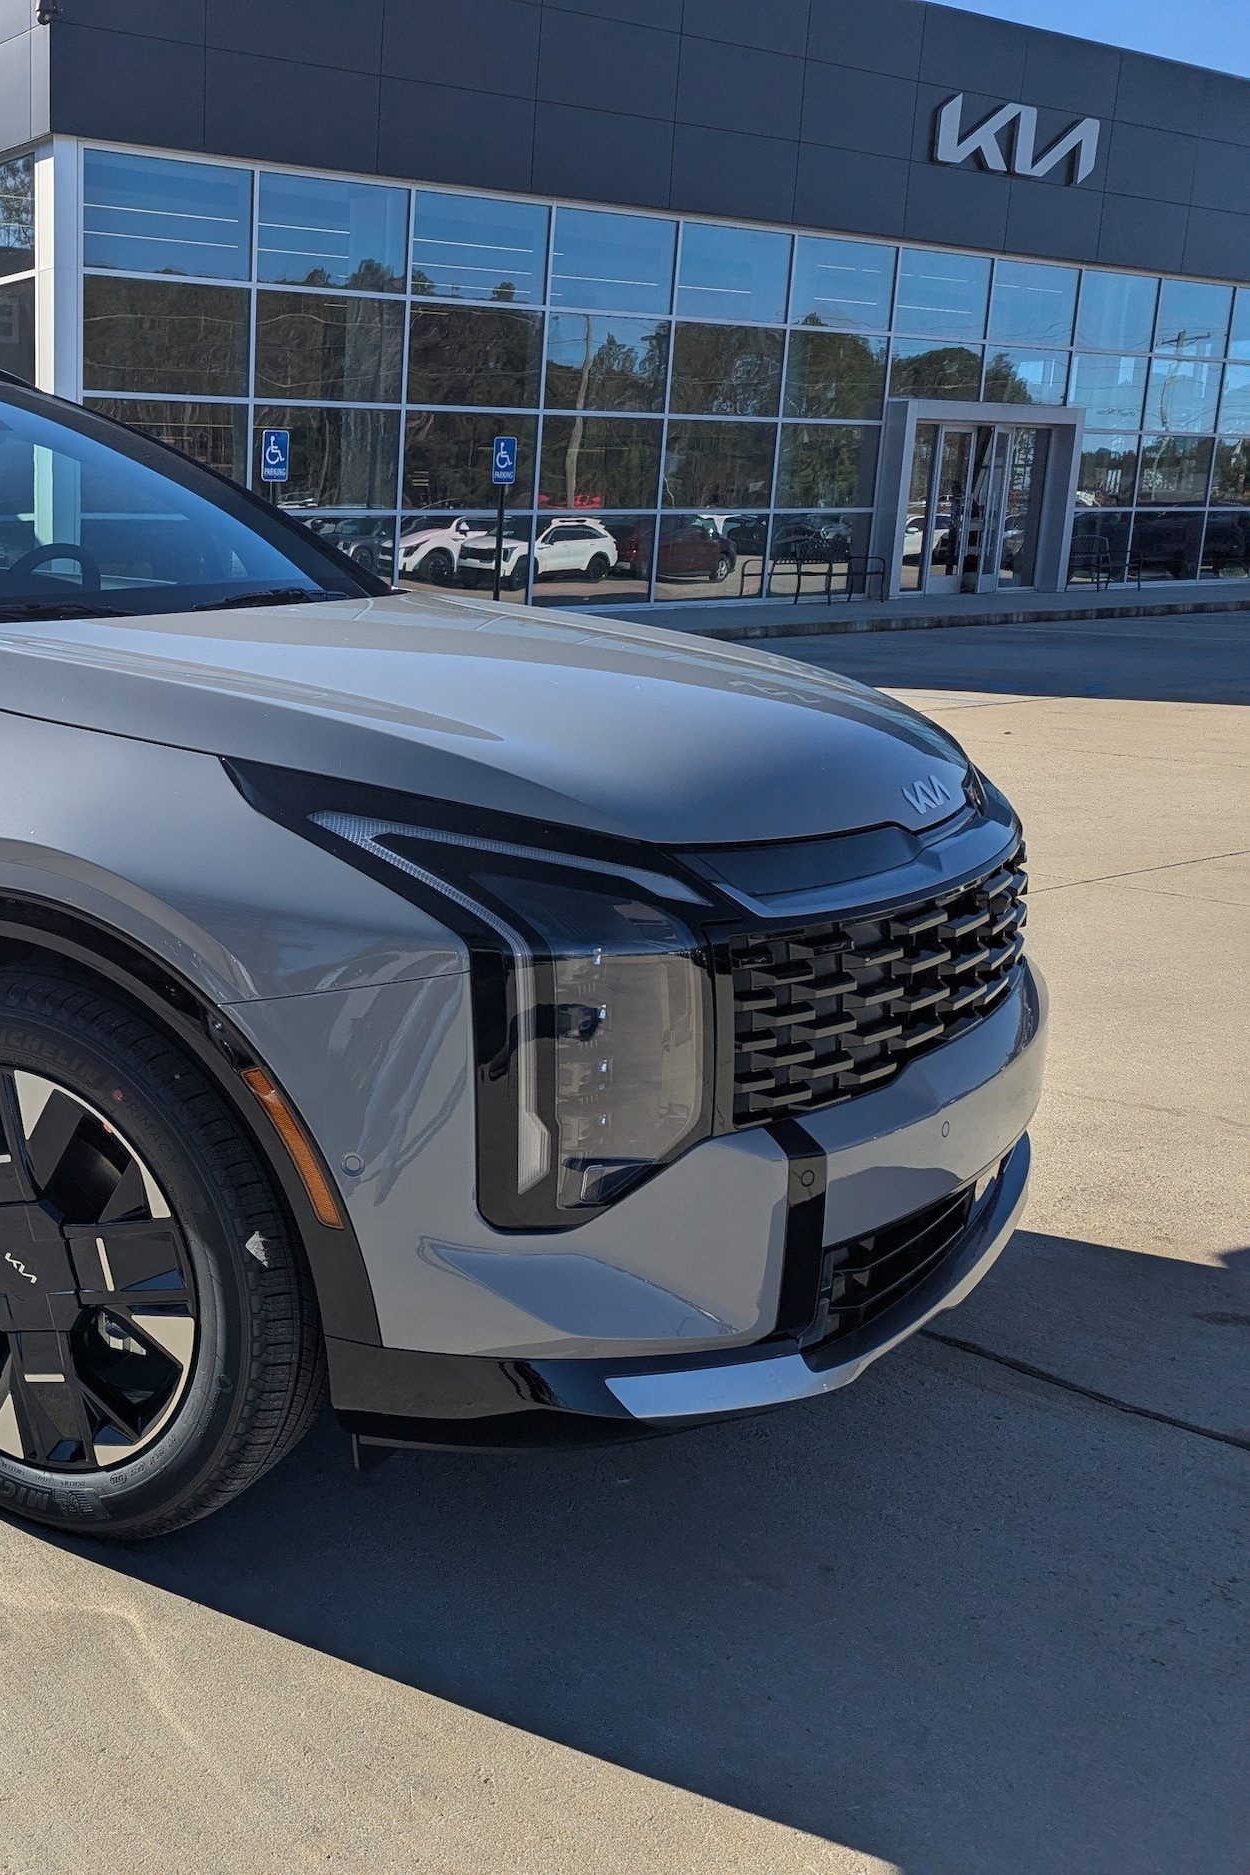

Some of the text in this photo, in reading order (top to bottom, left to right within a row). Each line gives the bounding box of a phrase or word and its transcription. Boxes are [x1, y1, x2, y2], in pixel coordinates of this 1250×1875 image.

[936, 92, 1101, 185] KIA
[264, 467, 286, 476] PARKING
[494, 471, 513, 479] PARKING
[901, 775, 952, 815] KIA
[4, 1252, 38, 1284] KIA
